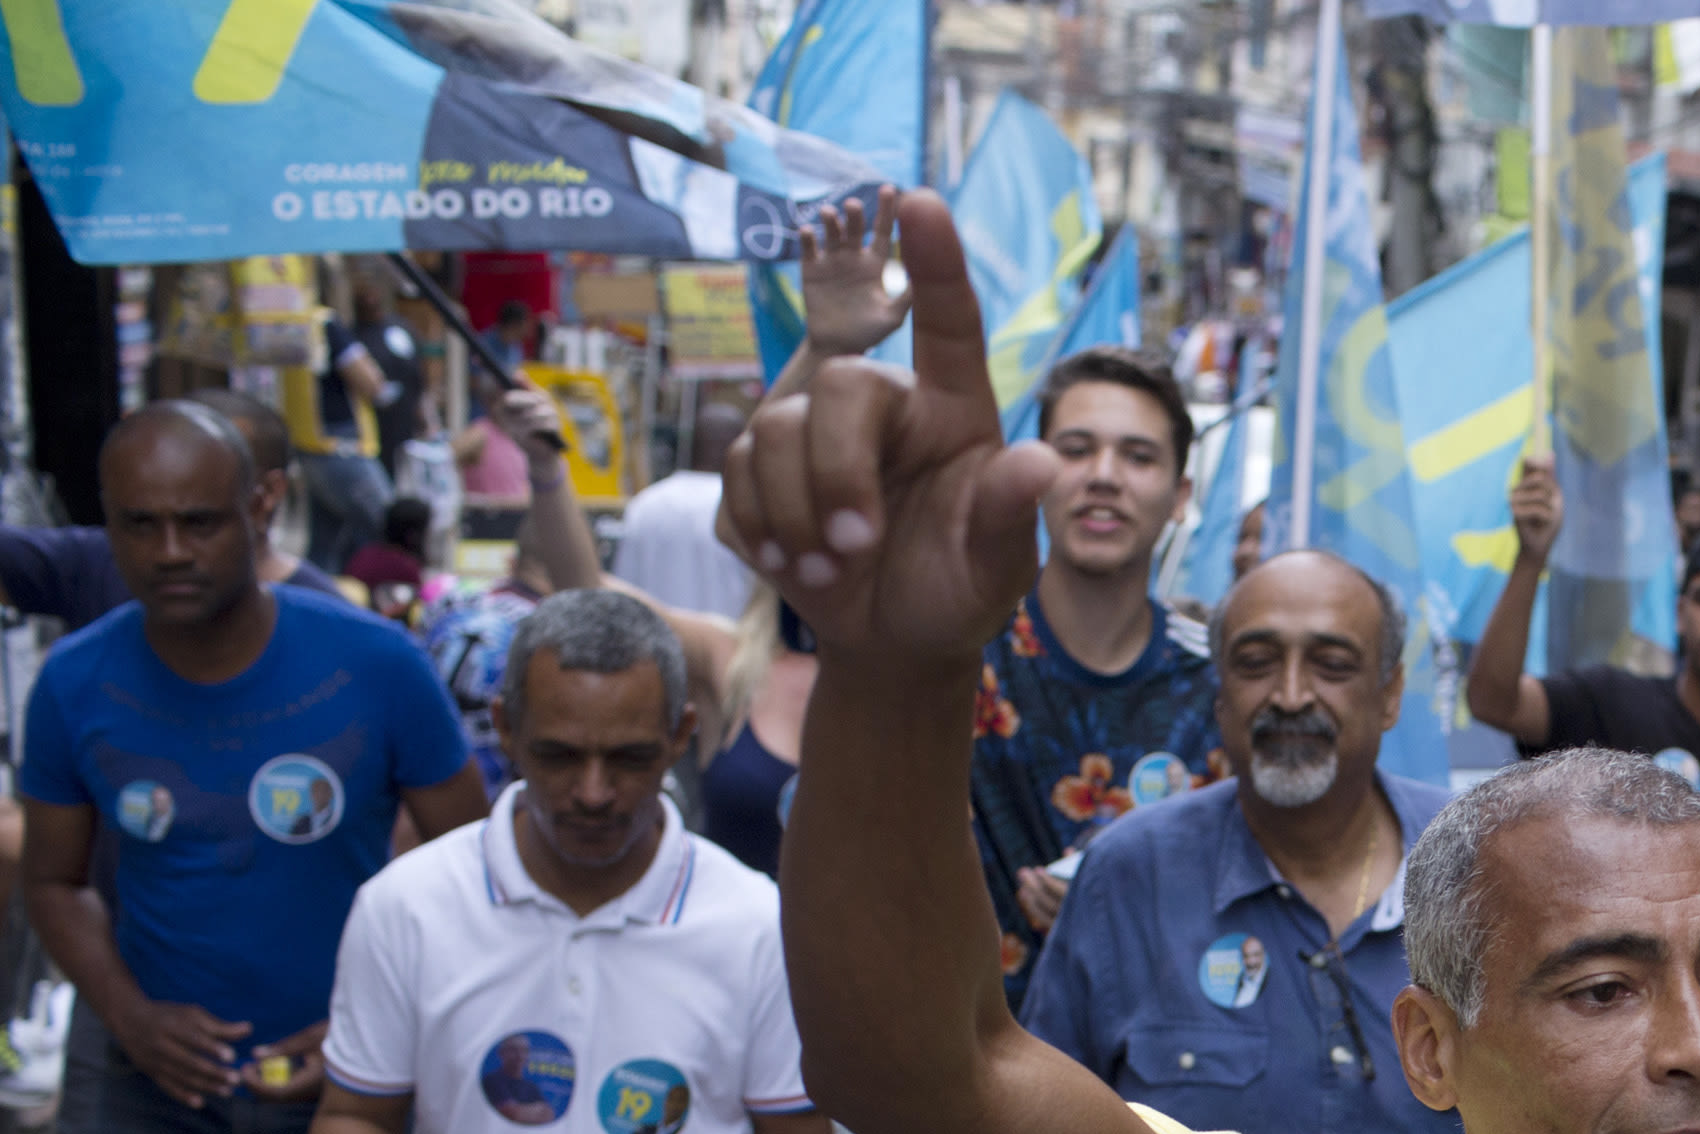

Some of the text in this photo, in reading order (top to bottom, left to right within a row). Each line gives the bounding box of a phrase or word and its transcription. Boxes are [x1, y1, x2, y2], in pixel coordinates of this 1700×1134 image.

[284, 163, 407, 184] CORAGEM
[272, 186, 614, 221] O ESTADO DO RIO
[616, 1086, 653, 1121] 19
